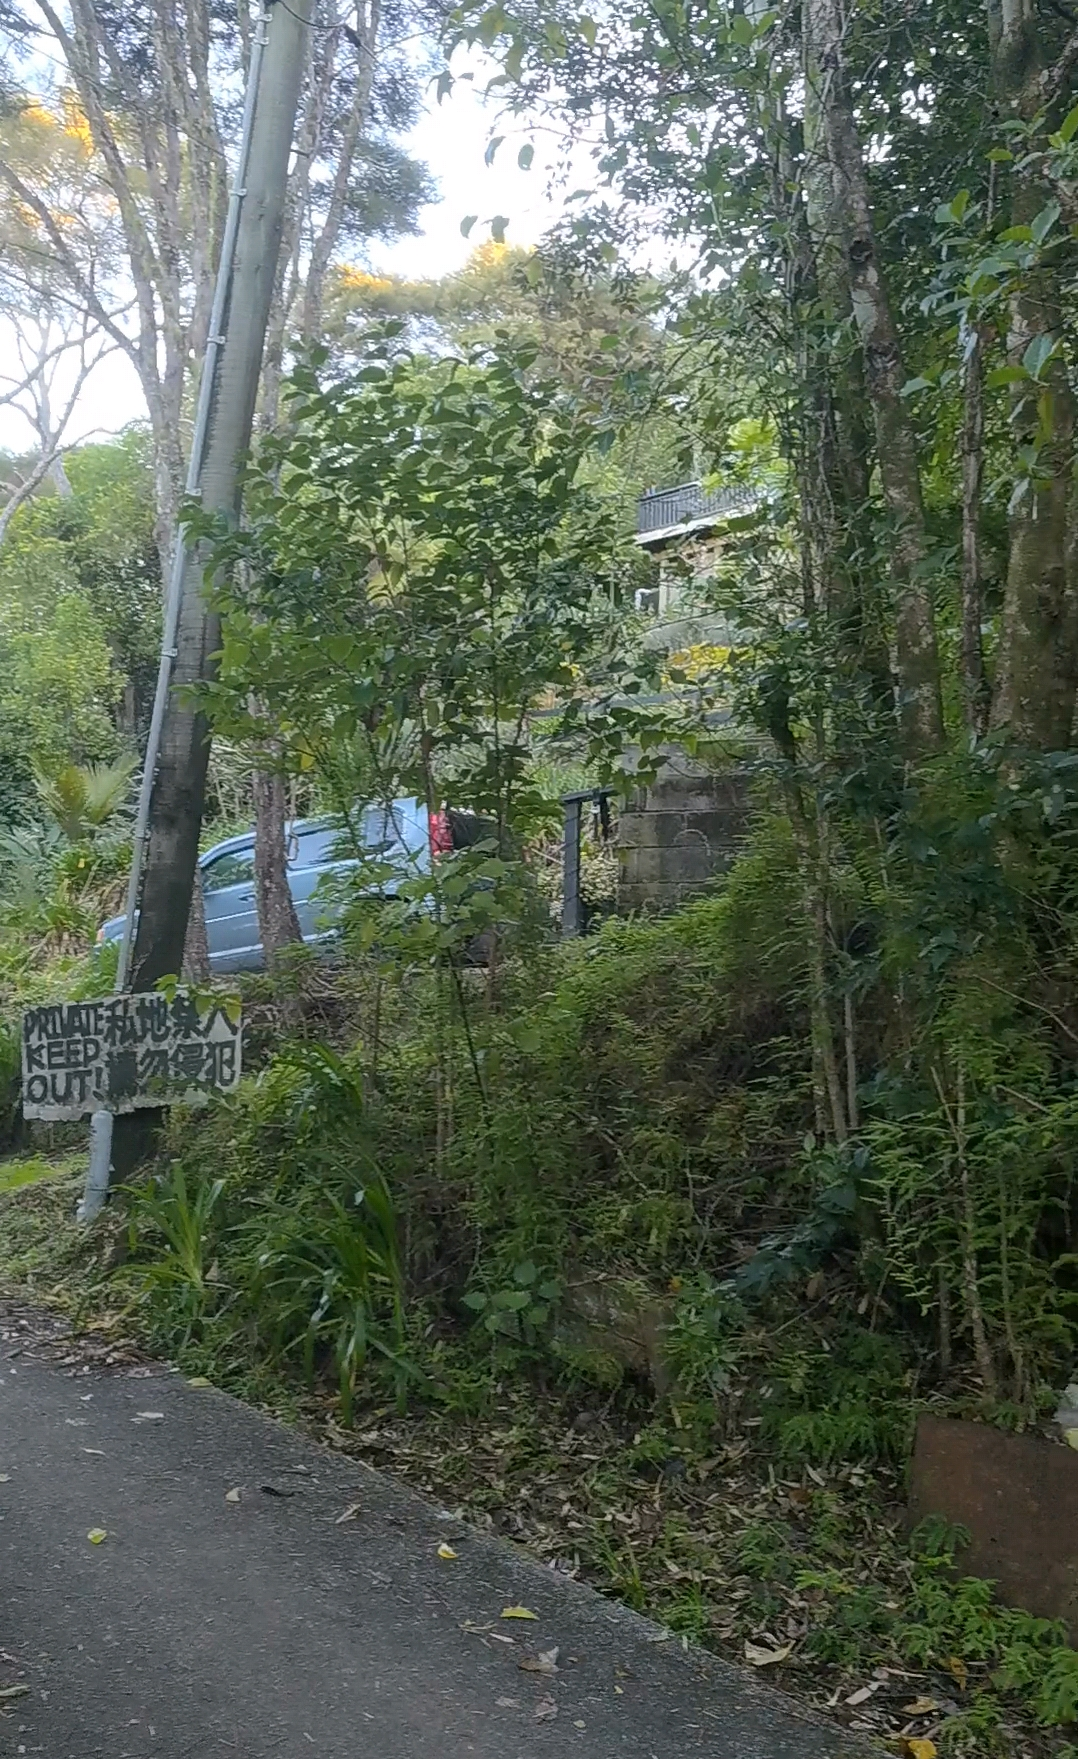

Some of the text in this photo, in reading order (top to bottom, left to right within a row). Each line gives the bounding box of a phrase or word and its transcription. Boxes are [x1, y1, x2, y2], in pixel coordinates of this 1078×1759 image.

[24, 1002, 104, 1042] PRIVATE
[26, 1038, 100, 1074] KEEP
[27, 1067, 104, 1104] OUT!
